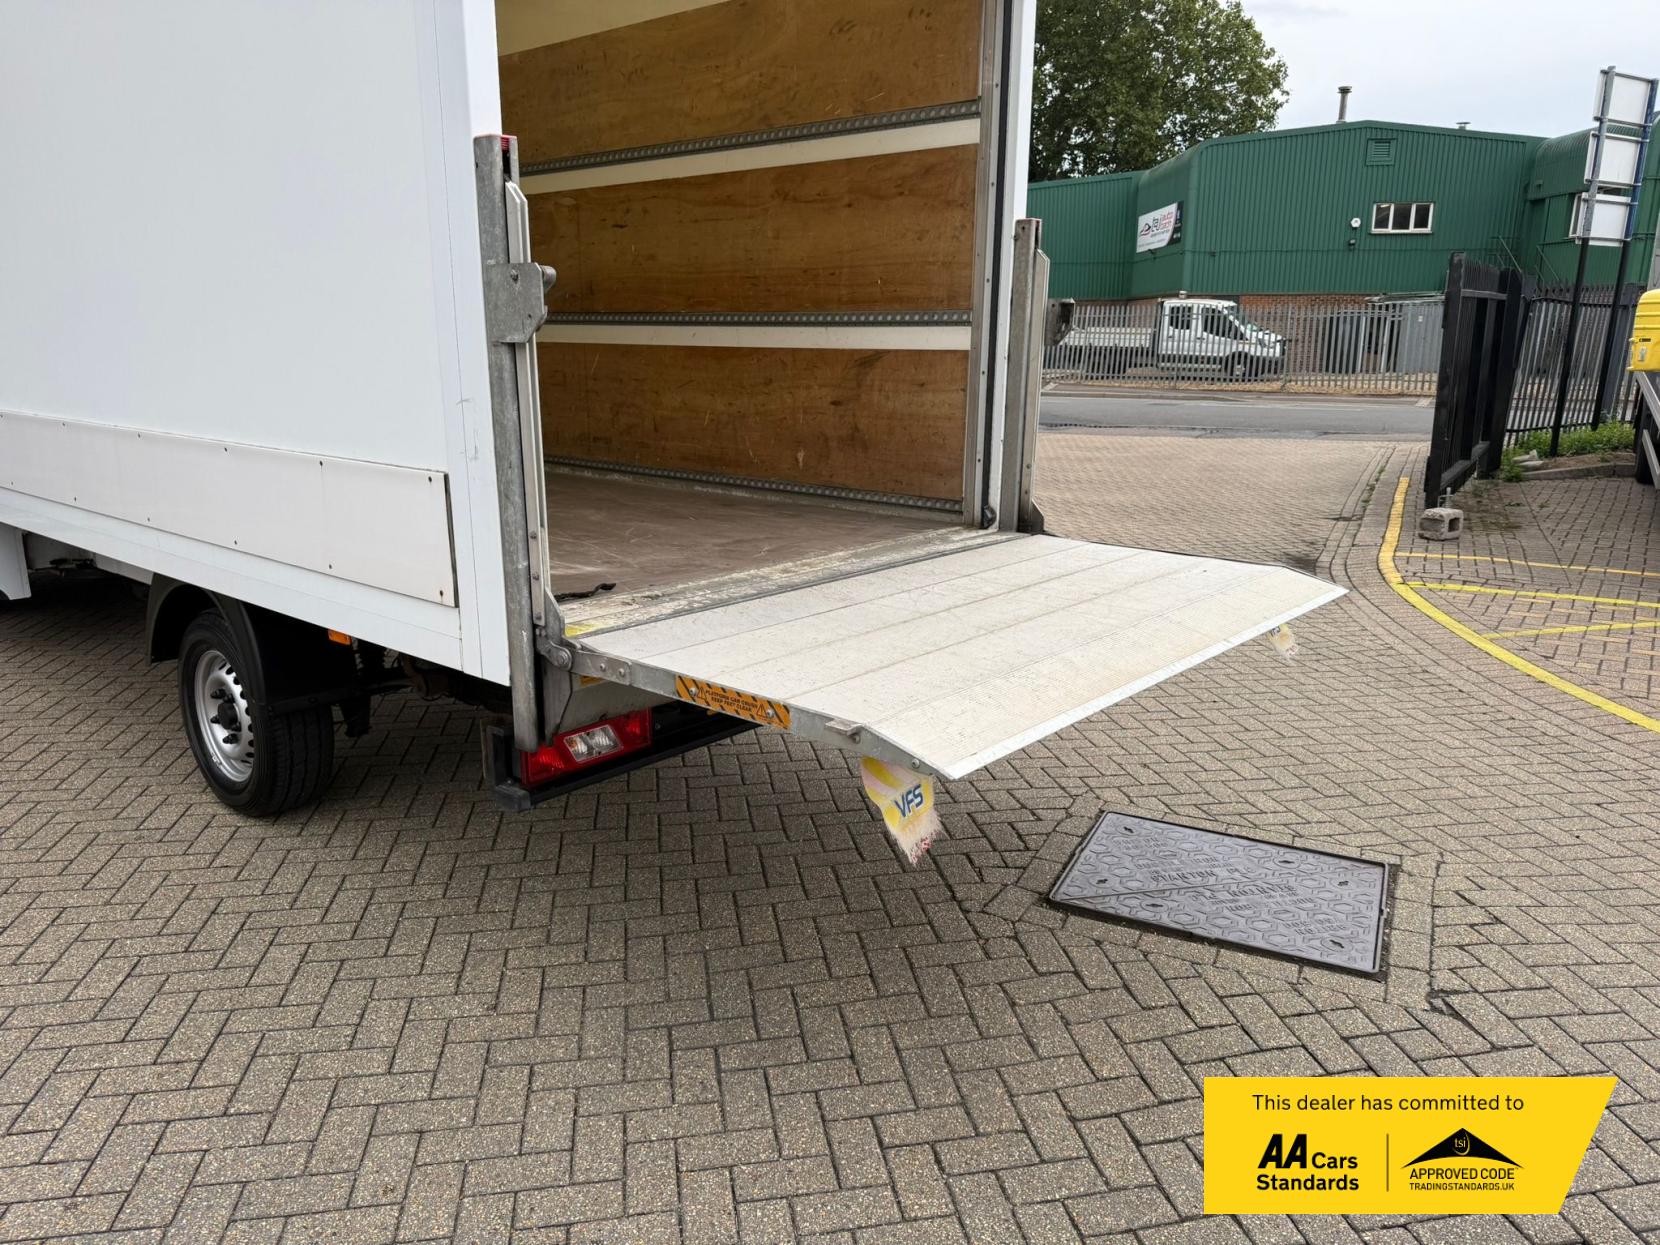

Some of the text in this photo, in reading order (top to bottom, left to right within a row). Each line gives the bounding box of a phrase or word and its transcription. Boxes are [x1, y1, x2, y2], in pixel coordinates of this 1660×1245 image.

[711, 696, 752, 712] KEEP FEET CLEAR
[729, 695, 741, 704] CAN
[894, 784, 923, 817] VFS
